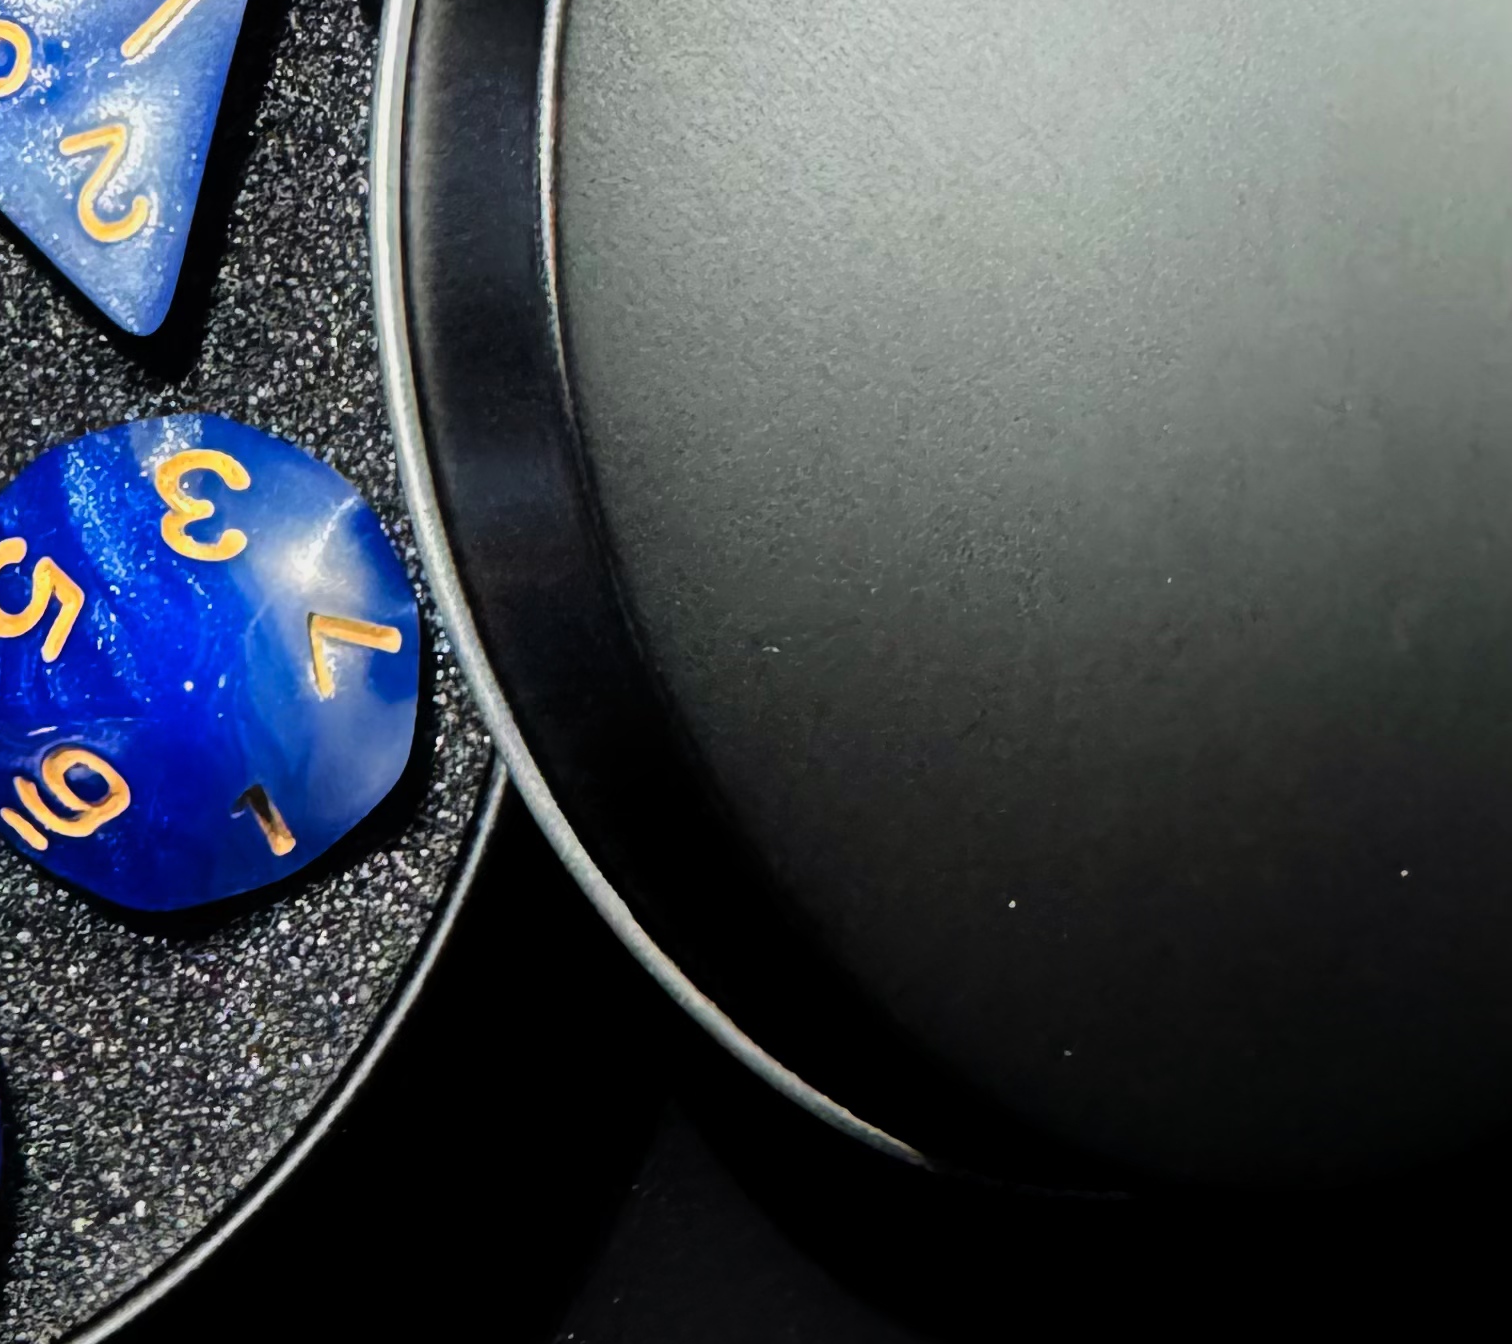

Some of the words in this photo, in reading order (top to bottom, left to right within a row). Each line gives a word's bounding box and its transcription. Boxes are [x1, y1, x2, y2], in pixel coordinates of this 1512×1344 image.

[59, 123, 149, 243] 2
[155, 449, 251, 561] 3
[308, 611, 402, 700] 7
